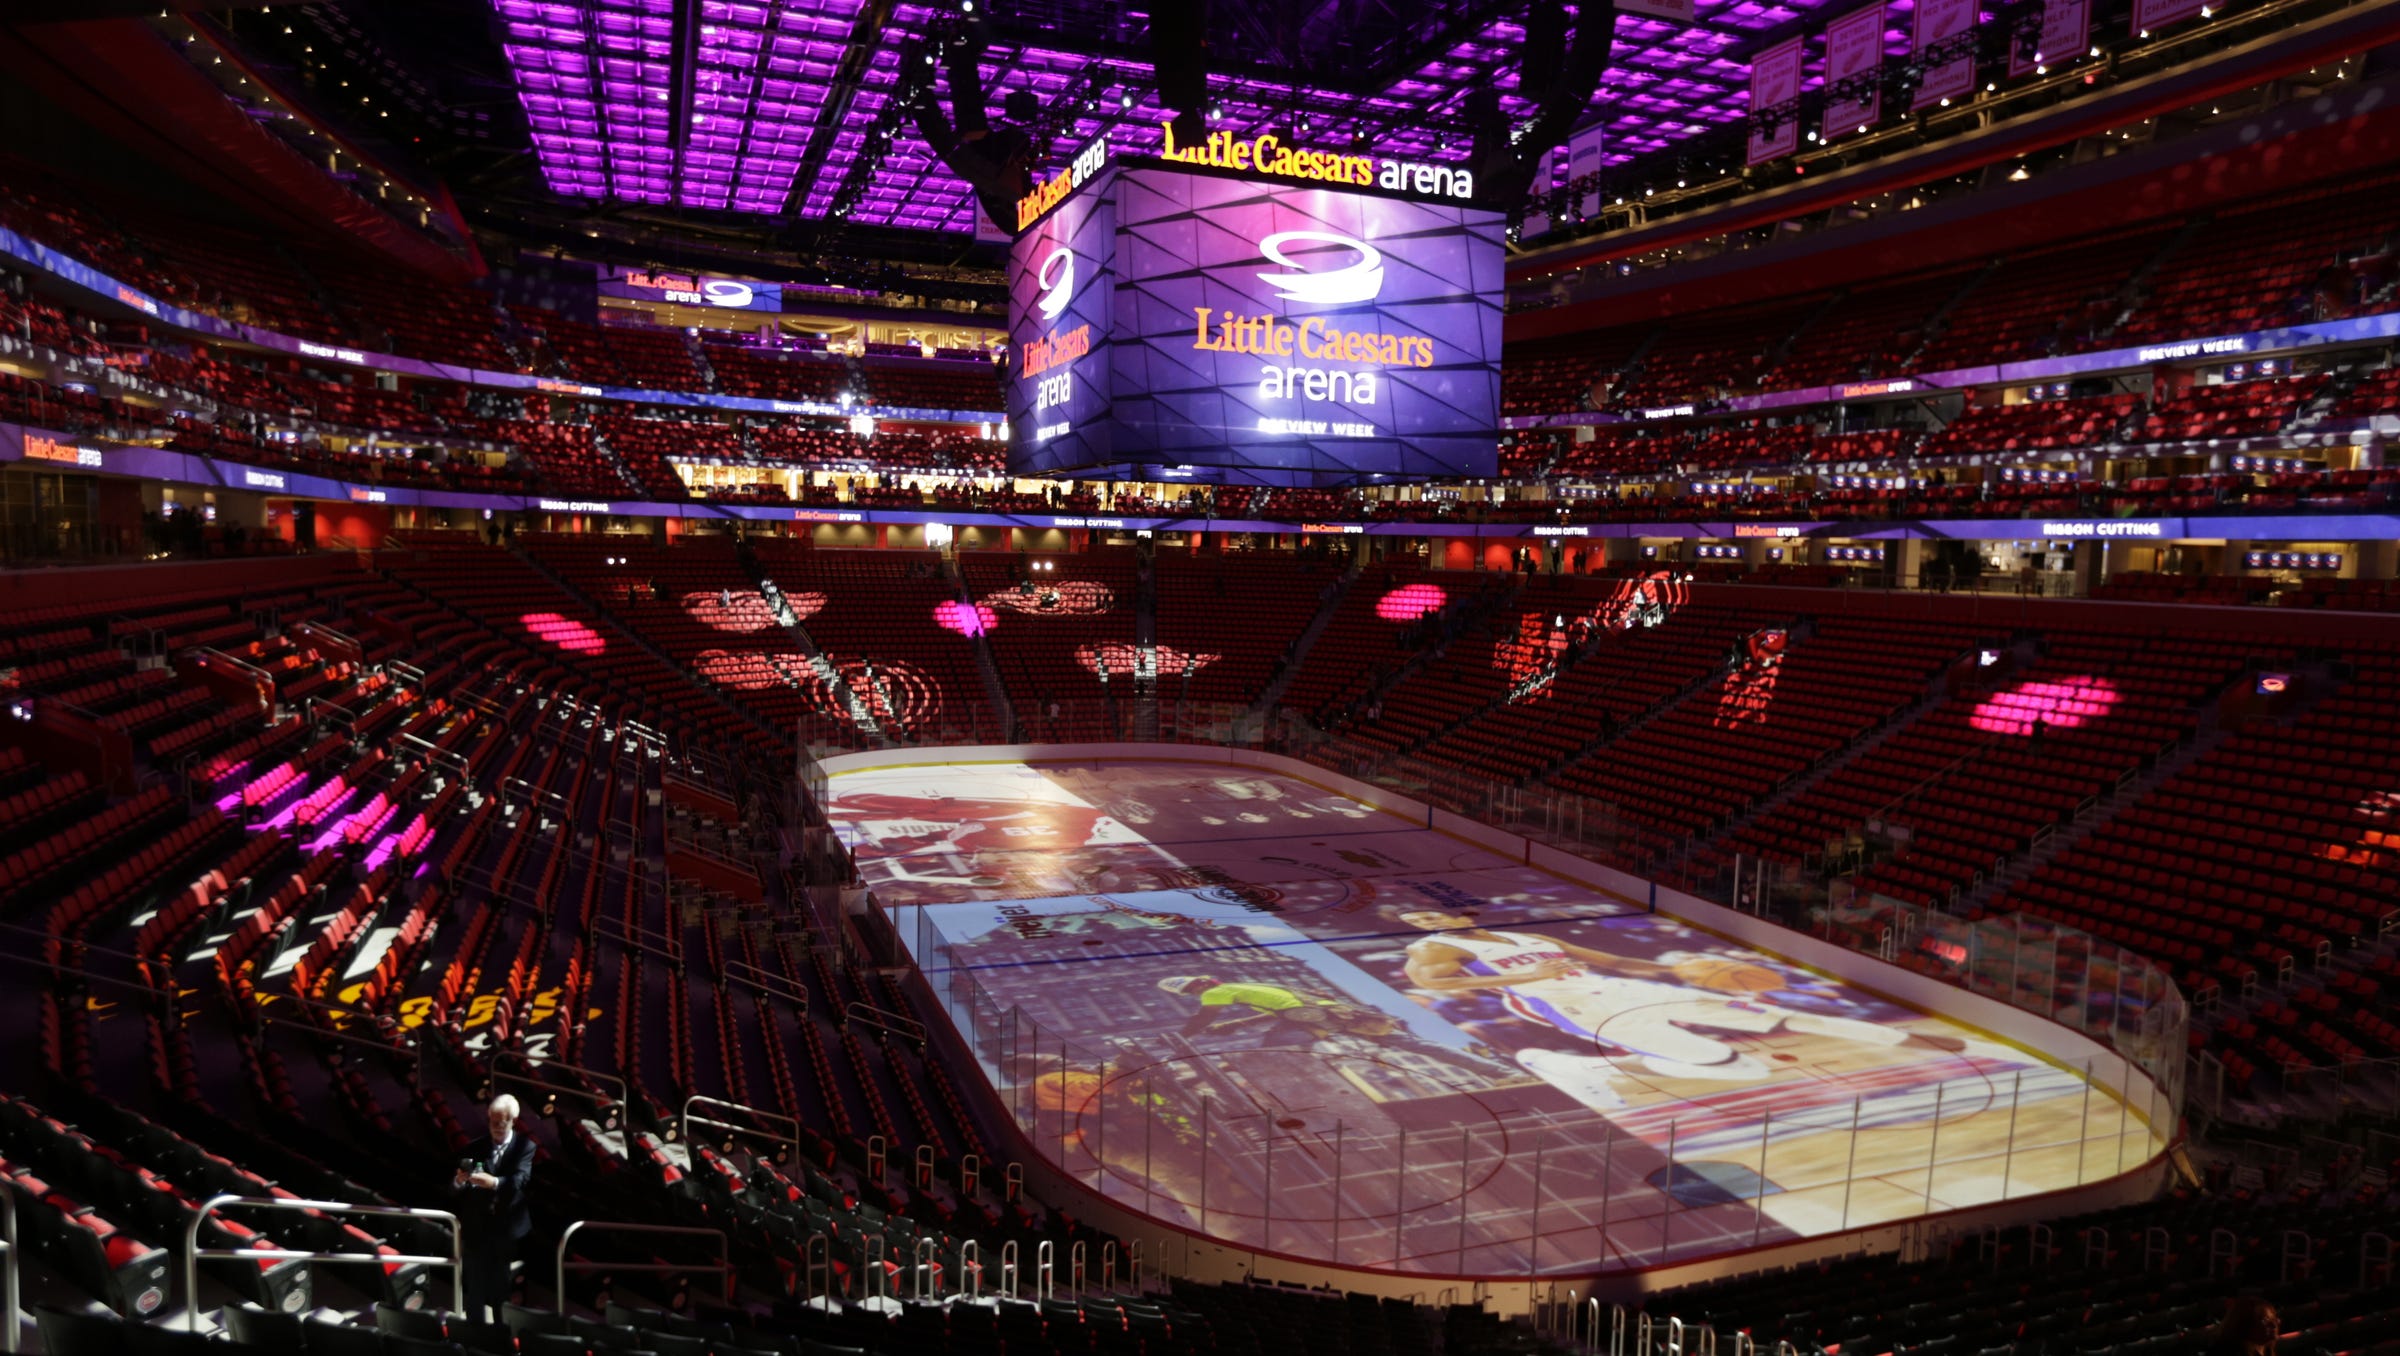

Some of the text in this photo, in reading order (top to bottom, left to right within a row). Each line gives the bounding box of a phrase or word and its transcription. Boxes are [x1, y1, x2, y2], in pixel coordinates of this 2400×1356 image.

[1072, 138, 1105, 188] arena
[1253, 134, 1373, 186] Caesars
[1379, 160, 1473, 198] arena
[659, 275, 701, 292] Caesas
[665, 290, 702, 303] arena
[1193, 307, 1434, 368] Little Caesars
[1023, 325, 1090, 379] Little Caesars
[2140, 338, 2243, 361] PREVIEW WEEK
[1038, 371, 1070, 411] arena
[1259, 365, 1376, 405] arena
[1888, 381, 1912, 392] arena
[1057, 421, 1070, 436] WEEK
[1258, 418, 1375, 437] PREVIEW WEEK
[48, 438, 78, 463] Caesars
[78, 446, 102, 467] arena
[569, 501, 609, 512] CUTTING
[838, 513, 861, 521] arena
[1055, 518, 1123, 528] RIBBON CUTTING
[1343, 525, 1363, 534] arena
[1777, 526, 1799, 537] arena
[2043, 523, 2160, 536] RIBBON CUTTING
